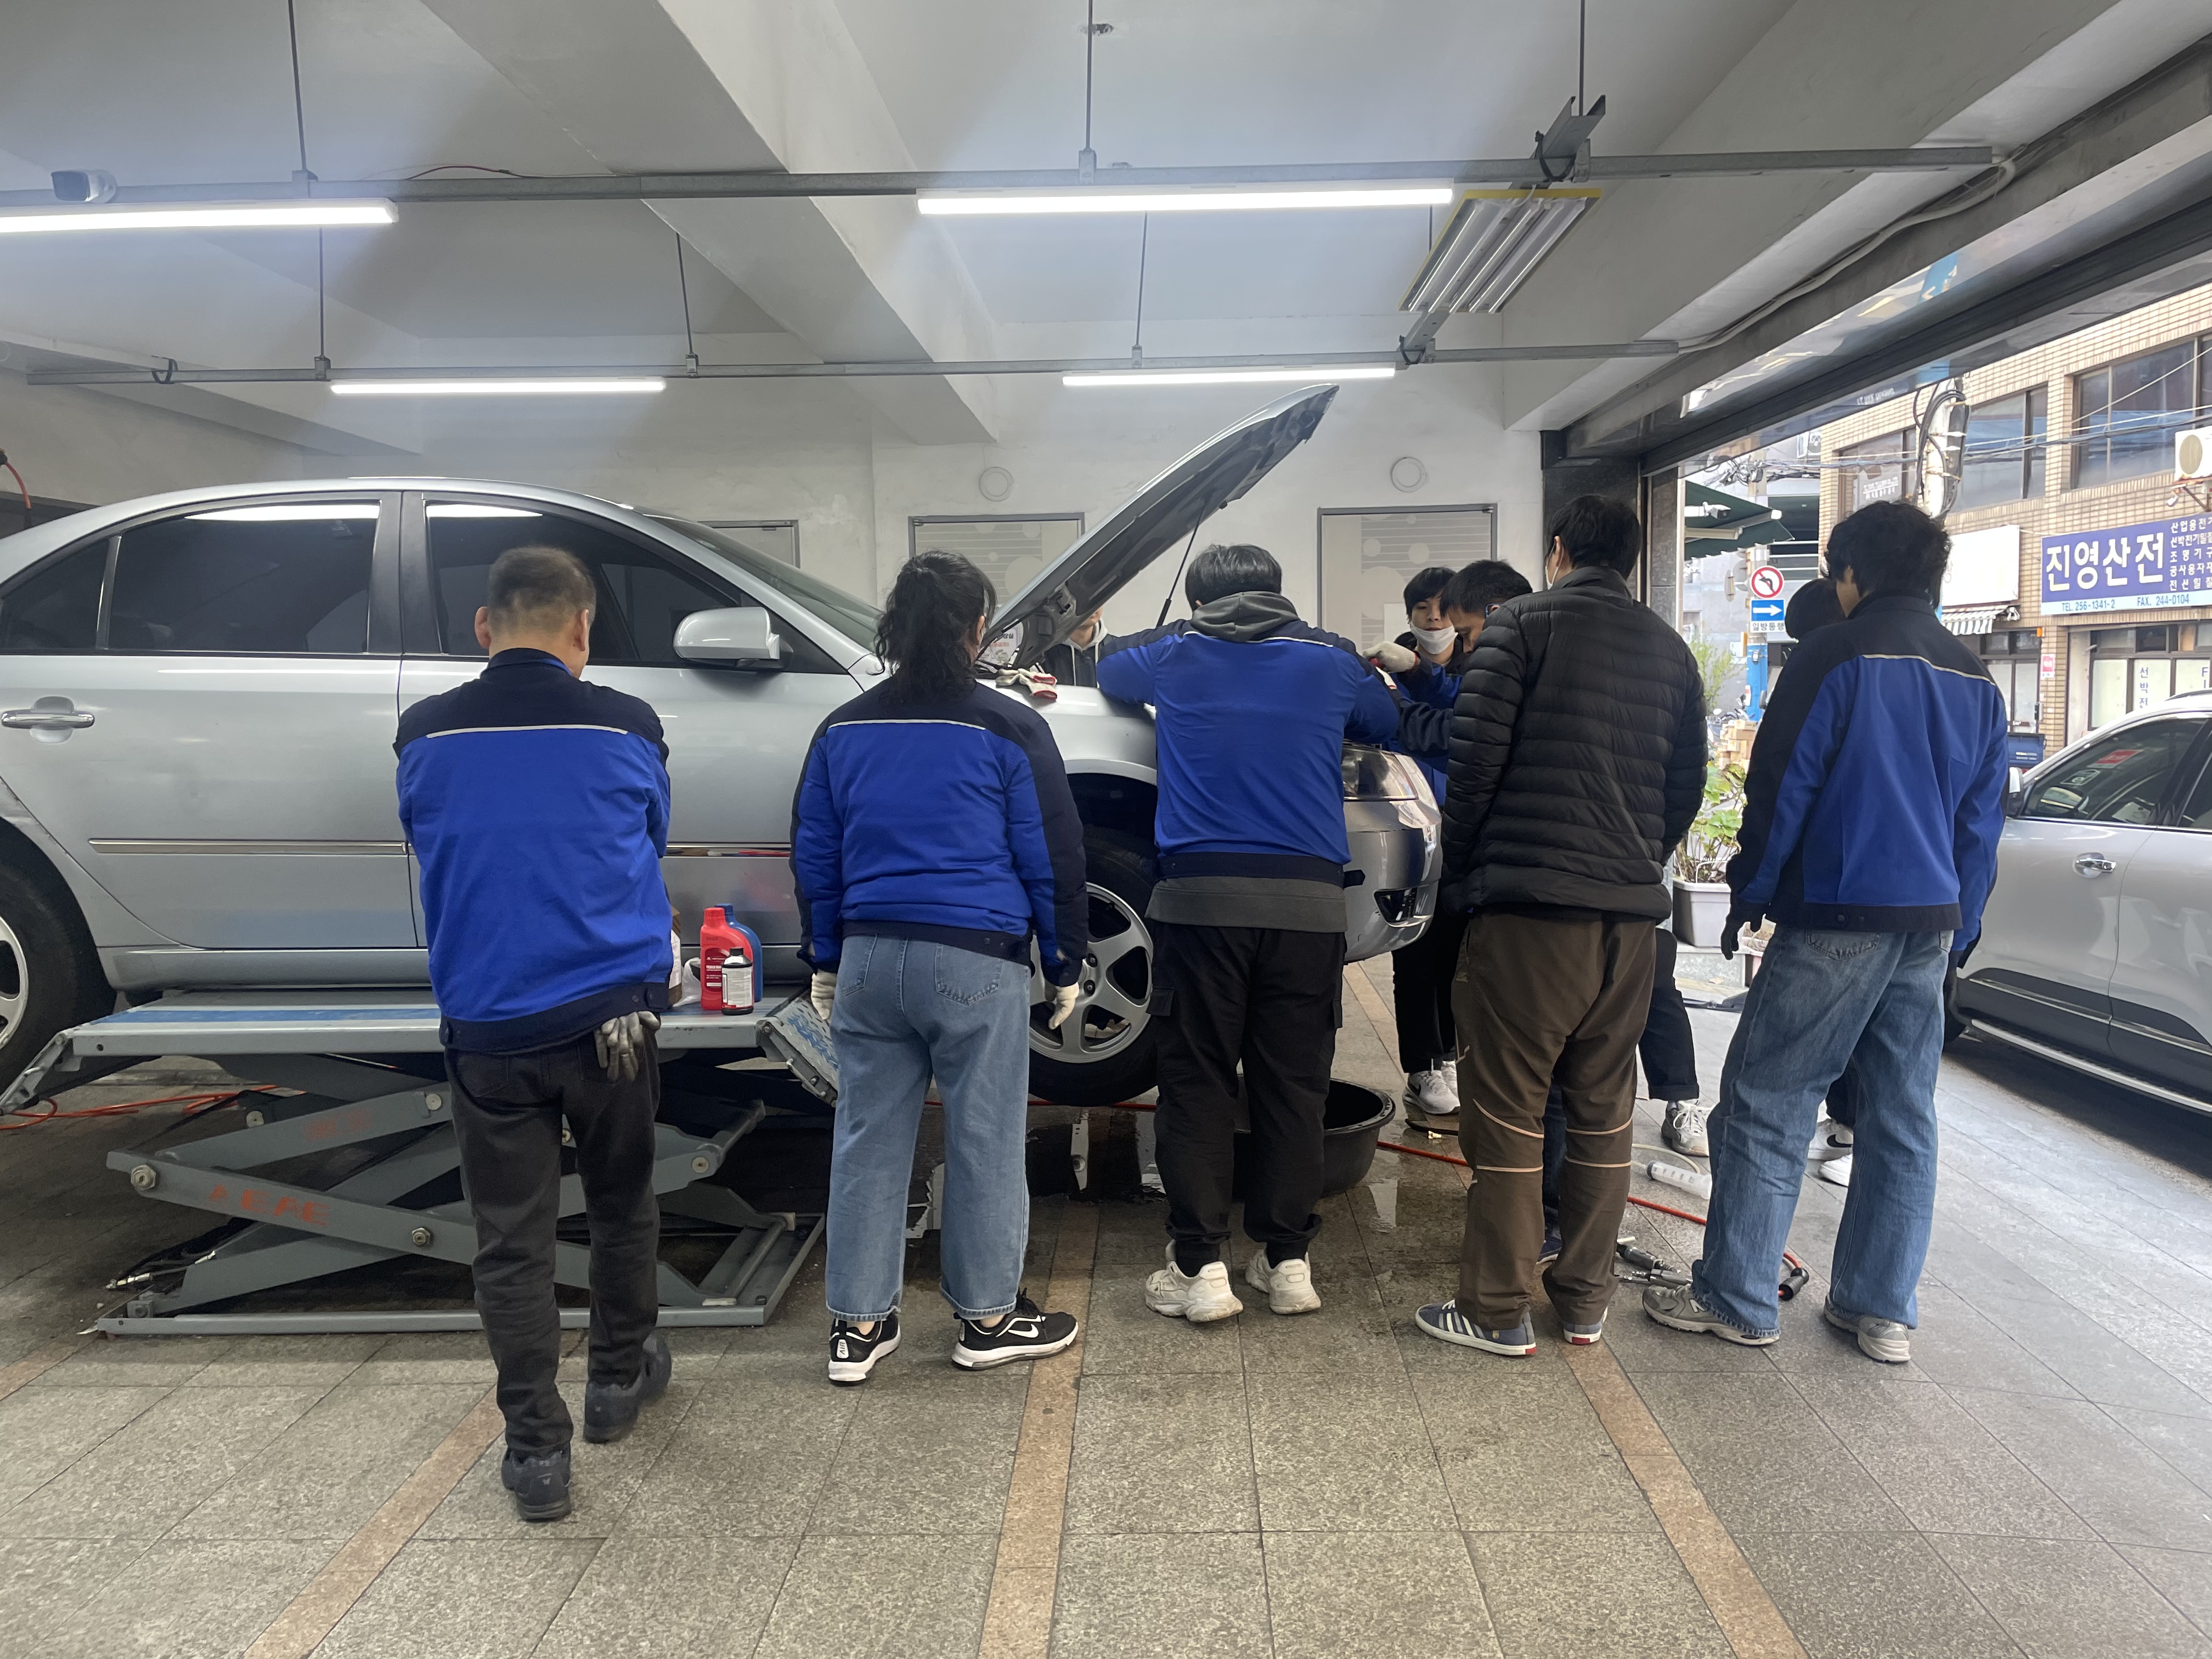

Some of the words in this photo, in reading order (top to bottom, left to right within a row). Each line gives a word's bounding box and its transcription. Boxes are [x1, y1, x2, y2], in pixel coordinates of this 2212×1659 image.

[2046, 532, 2164, 592] 진영산전
[2137, 597, 2152, 606] FAX.
[2156, 594, 2190, 606] 244-0104
[1753, 622, 1784, 631] 일방통행
